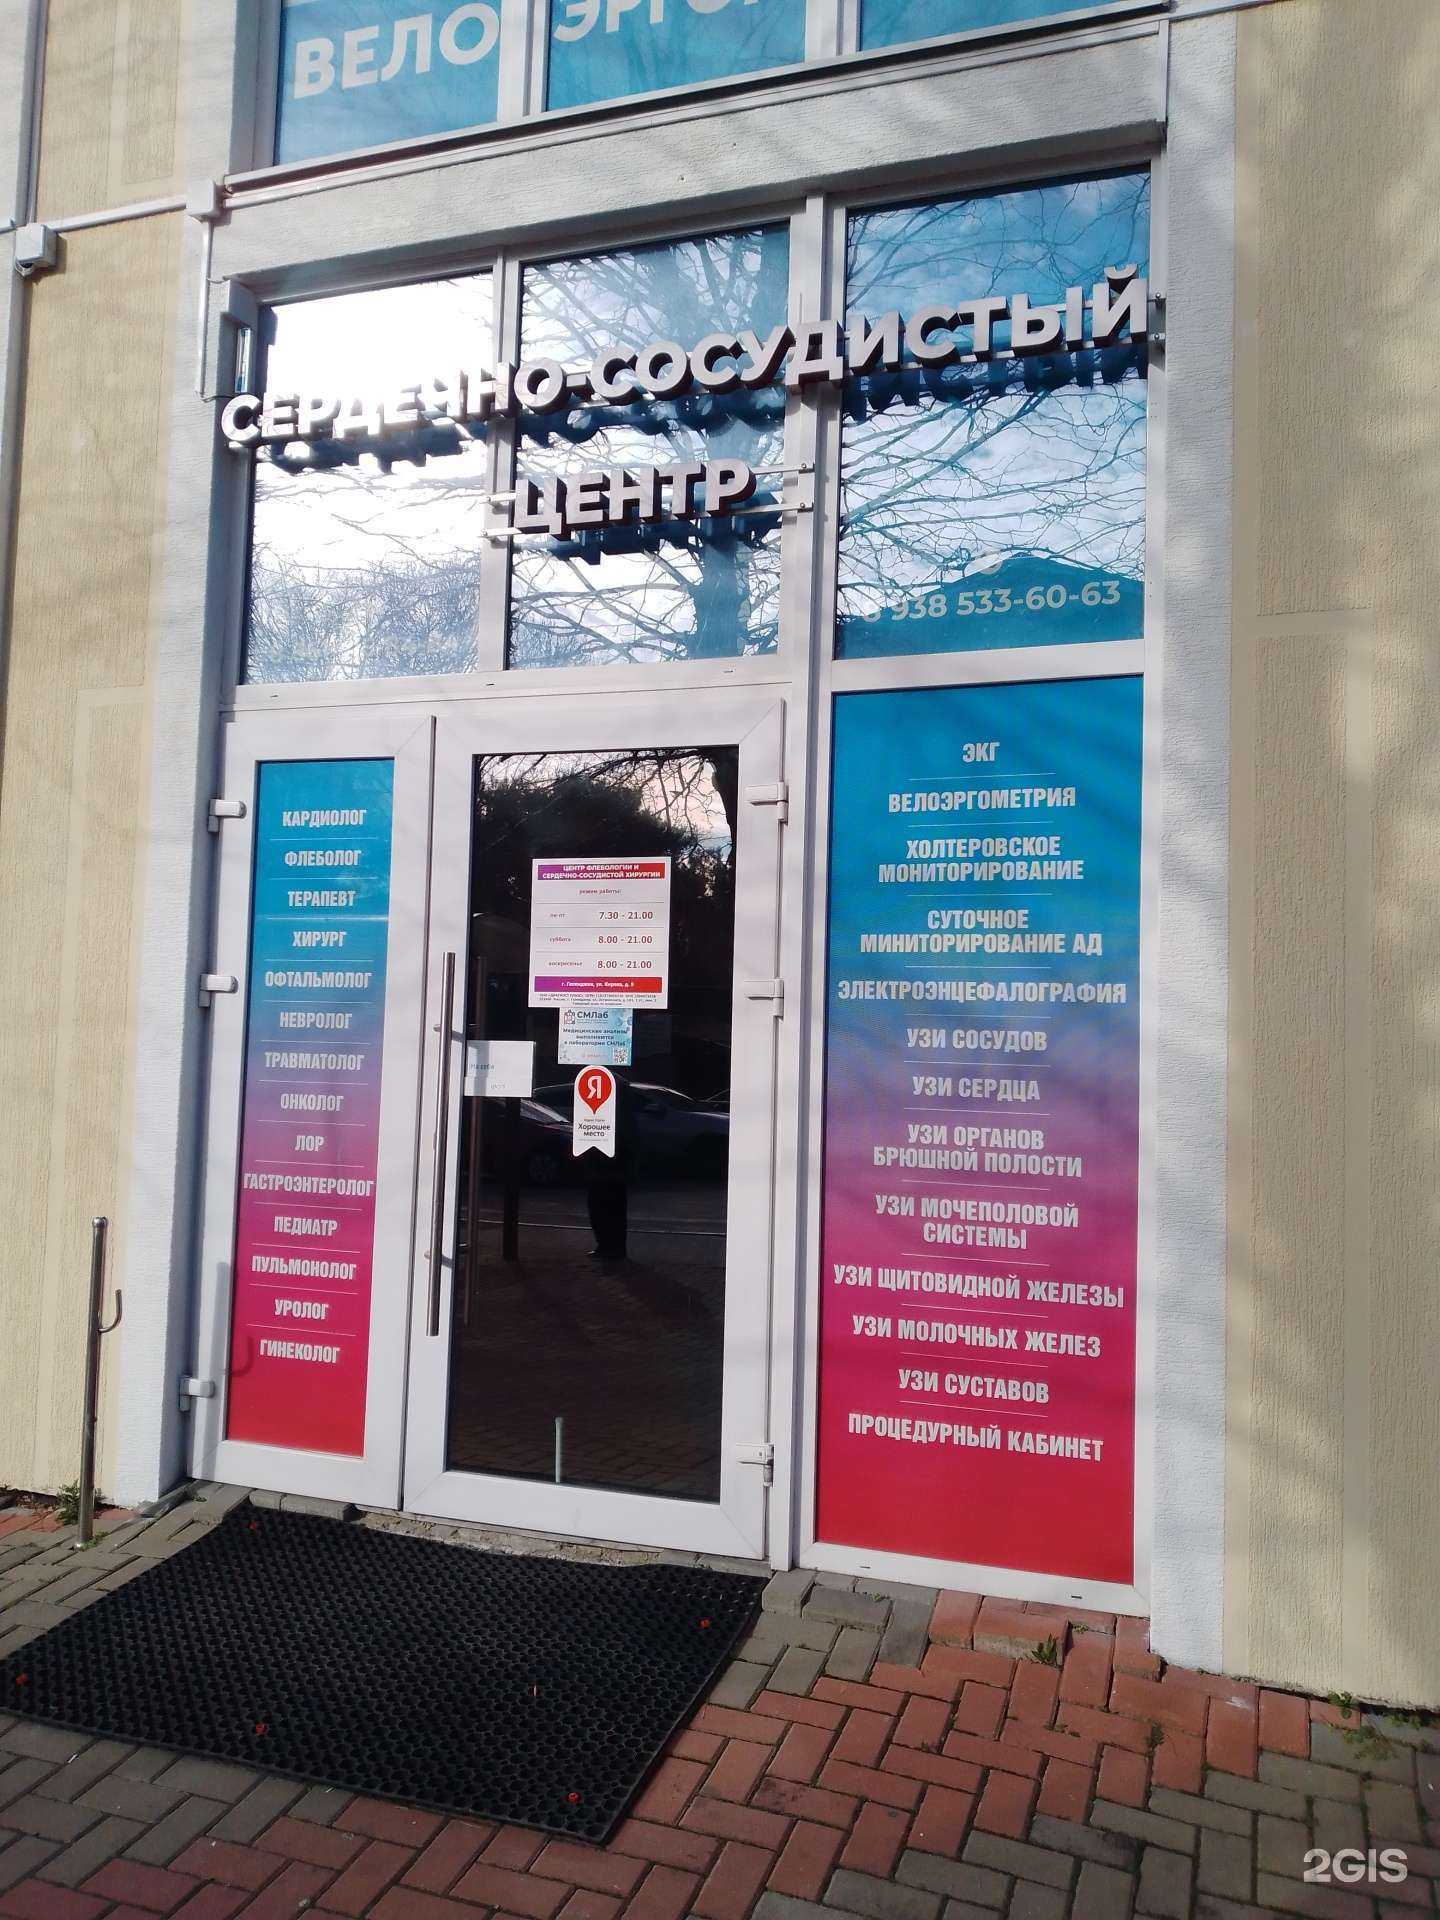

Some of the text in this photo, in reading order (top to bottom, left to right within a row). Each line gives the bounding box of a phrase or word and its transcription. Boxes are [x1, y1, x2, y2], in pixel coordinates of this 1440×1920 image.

[293, 2, 501, 100] ВЕЛО
[221, 263, 1148, 444] СЕРДЕЧНО-СОСУДИСТЫЙ
[513, 458, 753, 537] ЦЕНТР
[891, 593, 947, 621] 938
[956, 580, 1121, 616] 533-60-63
[962, 742, 1000, 763] ЭКГ
[888, 787, 1076, 813] ВЕЛОЭРГОМЕТРИЯ
[282, 809, 367, 828] КАРДИОЛОГ
[284, 850, 361, 867] ФЛЕБОЛОГ
[906, 836, 1061, 859] ХОЛТЕРОВСКОЕ
[878, 860, 1084, 883] МОНИТОРИРОВАНИЕ
[288, 891, 355, 907] ТЕРАПЕВТ
[599, 911, 619, 919] 7.30
[628, 911, 653, 919] 21.00
[927, 909, 1029, 929] СУТОЧНОЕ
[292, 931, 347, 947] ХИРУРГ
[598, 935, 618, 944] 8.00
[627, 935, 653, 944] 21.00
[860, 933, 1103, 956] МИНИТОРИРОВАНИЕ АД
[597, 960, 617, 969] 8.00
[626, 960, 652, 969] 21.00
[264, 971, 372, 988] ОФТАЛЬМОЛОГ
[838, 980, 1127, 1004] ЭЛЕКТРОЭНЦЕФАЛОГРАФИЯ
[279, 1012, 352, 1029] НЕВРОЛОГ
[577, 1011, 608, 1019] СМЛаб
[907, 1028, 1048, 1052] УЗИ СОСУДОВ
[264, 1052, 364, 1070] ТРАВМАТОЛОГ
[587, 1075, 602, 1099] Я
[912, 1076, 1040, 1102] УЗИ СЕРДЦА
[280, 1093, 344, 1112] ОНКОЛОГ
[578, 1123, 611, 1131] Хорошее
[908, 1124, 1044, 1150] УЗИ ОРГАНОВ
[294, 1135, 325, 1152] ЛОР
[873, 1146, 1082, 1178] БРЮШНОЙ ПОЛОСТИ
[243, 1173, 374, 1196] ГАСТРОЭНТЕРОЛОГ
[876, 1194, 1079, 1228] УЗИ МОЧЕПОЛОВОЙ
[274, 1216, 338, 1236] ПЕДИАТР
[923, 1223, 1027, 1249] СИСТЕМЫ
[251, 1255, 357, 1280] ПУЛЬМОНОЛОГ
[833, 1264, 1124, 1308] УЗИ ЩИТОВИДНОЙ ЖЕЛЕЗЫ
[274, 1299, 329, 1320] УРОЛОГ
[852, 1315, 1101, 1358] УЗИ МОЛОЧНЫХ ЖЕЛЕЗ
[259, 1339, 340, 1363] ГИНЕКОЛОГ
[898, 1369, 1049, 1403] УЗИ СУСТАВОВ
[848, 1413, 1104, 1462] ПРОЦЕДУРНЫЙ КАБИНЕТ
